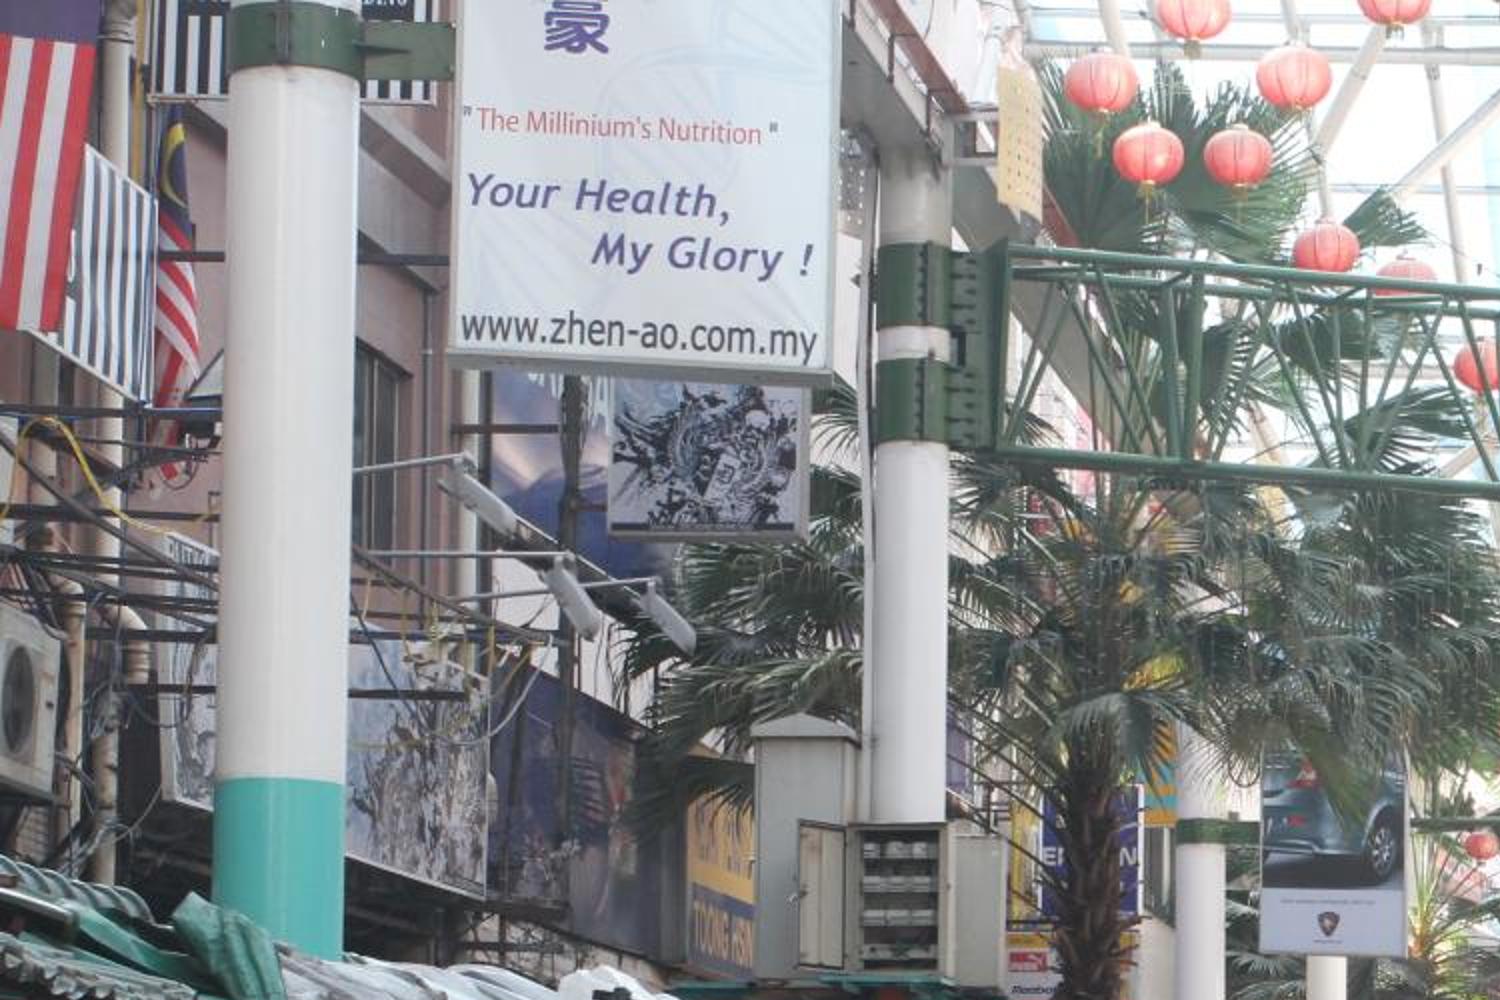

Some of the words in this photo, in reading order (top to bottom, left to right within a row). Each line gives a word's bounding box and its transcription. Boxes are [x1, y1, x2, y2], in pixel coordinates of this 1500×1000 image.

[526, 111, 652, 139] Millinium's
[658, 117, 762, 145] Nutrition
[467, 172, 562, 210] Your
[575, 178, 730, 227] Health,
[591, 232, 653, 275] My
[461, 309, 818, 365] www.zhen-ao.com.my
